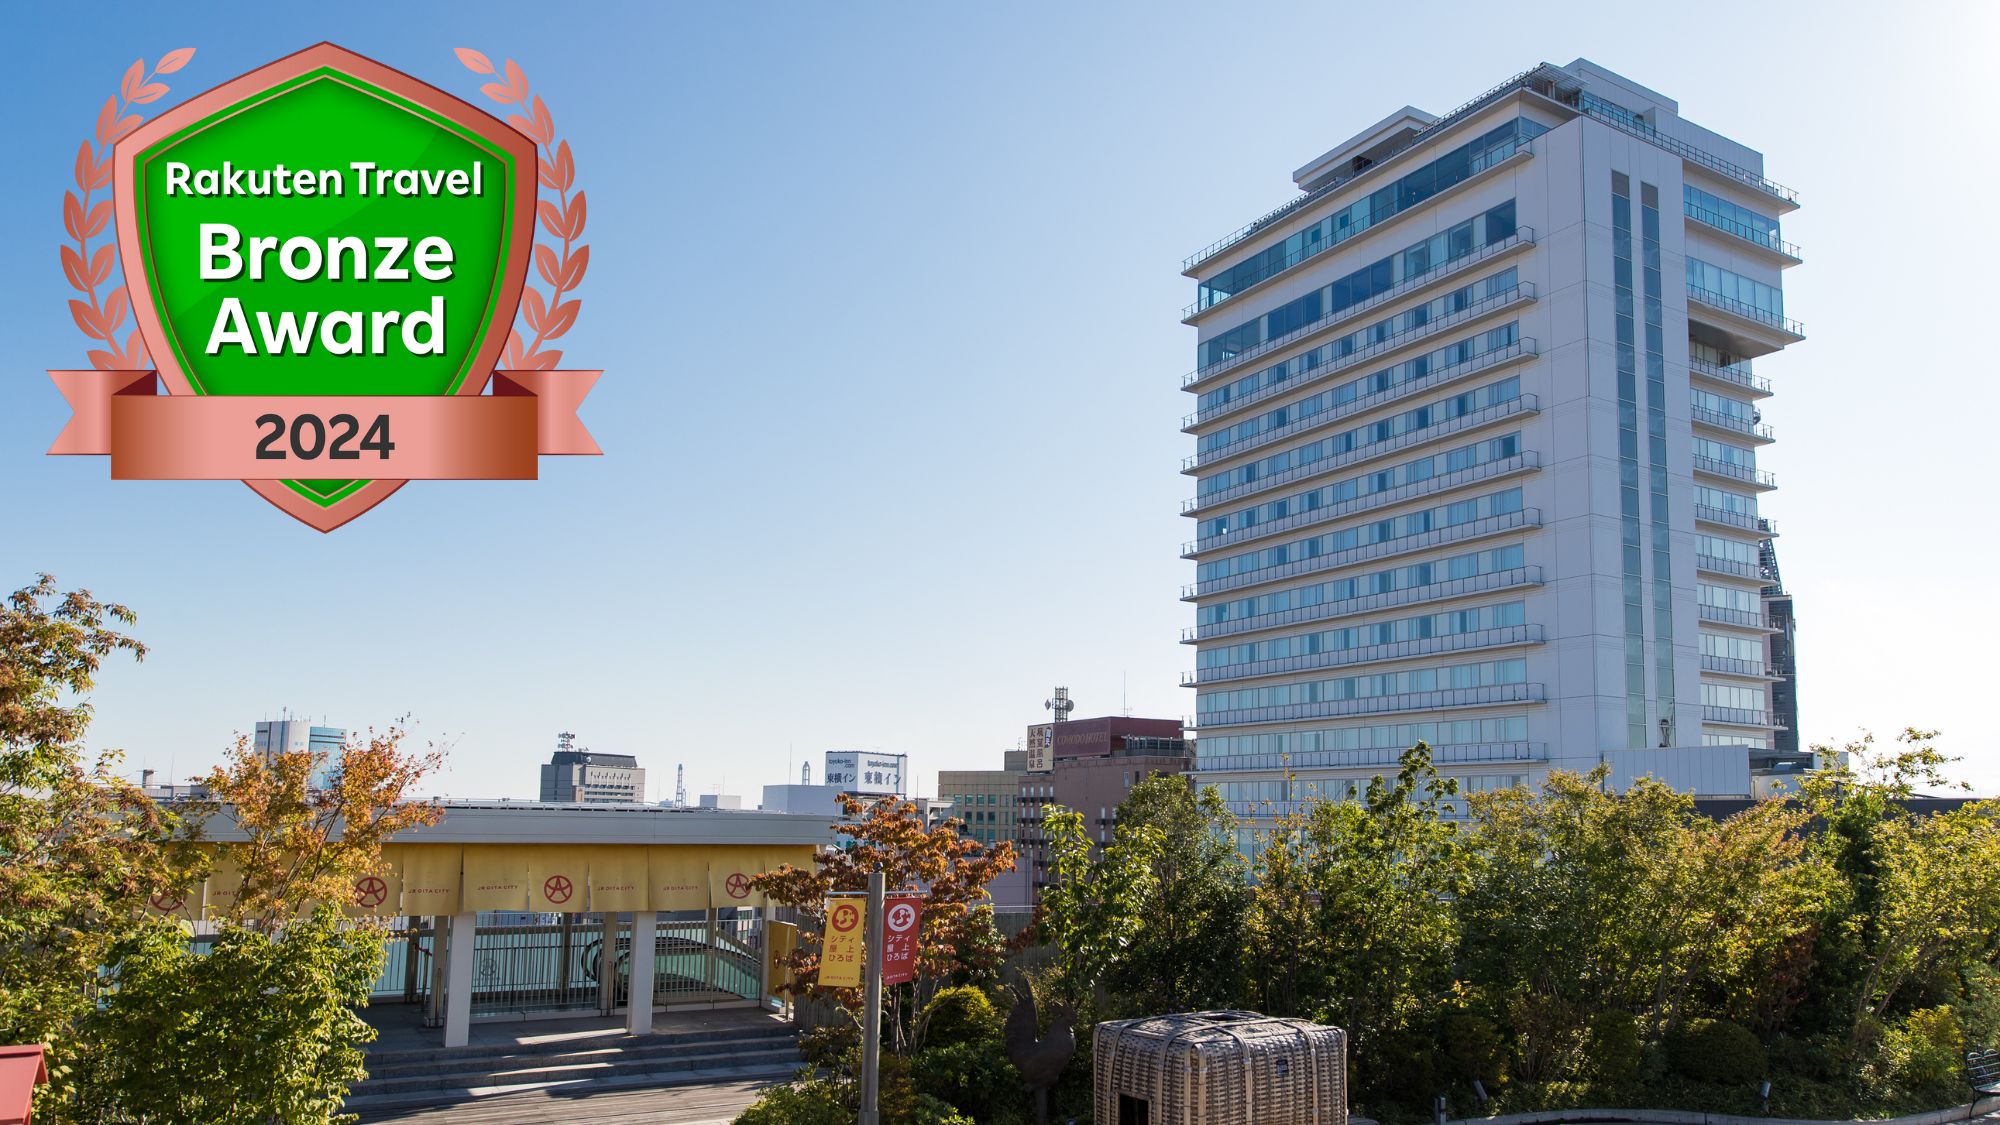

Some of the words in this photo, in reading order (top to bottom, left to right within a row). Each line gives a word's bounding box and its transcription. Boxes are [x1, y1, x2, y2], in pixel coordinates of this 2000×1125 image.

[826, 772, 857, 784] 東横イン
[864, 770, 902, 785] 東横イン
[831, 935, 854, 944] シティ
[887, 934, 911, 943] シティ
[828, 954, 854, 963] ひろば
[886, 953, 909, 962] ひろば
